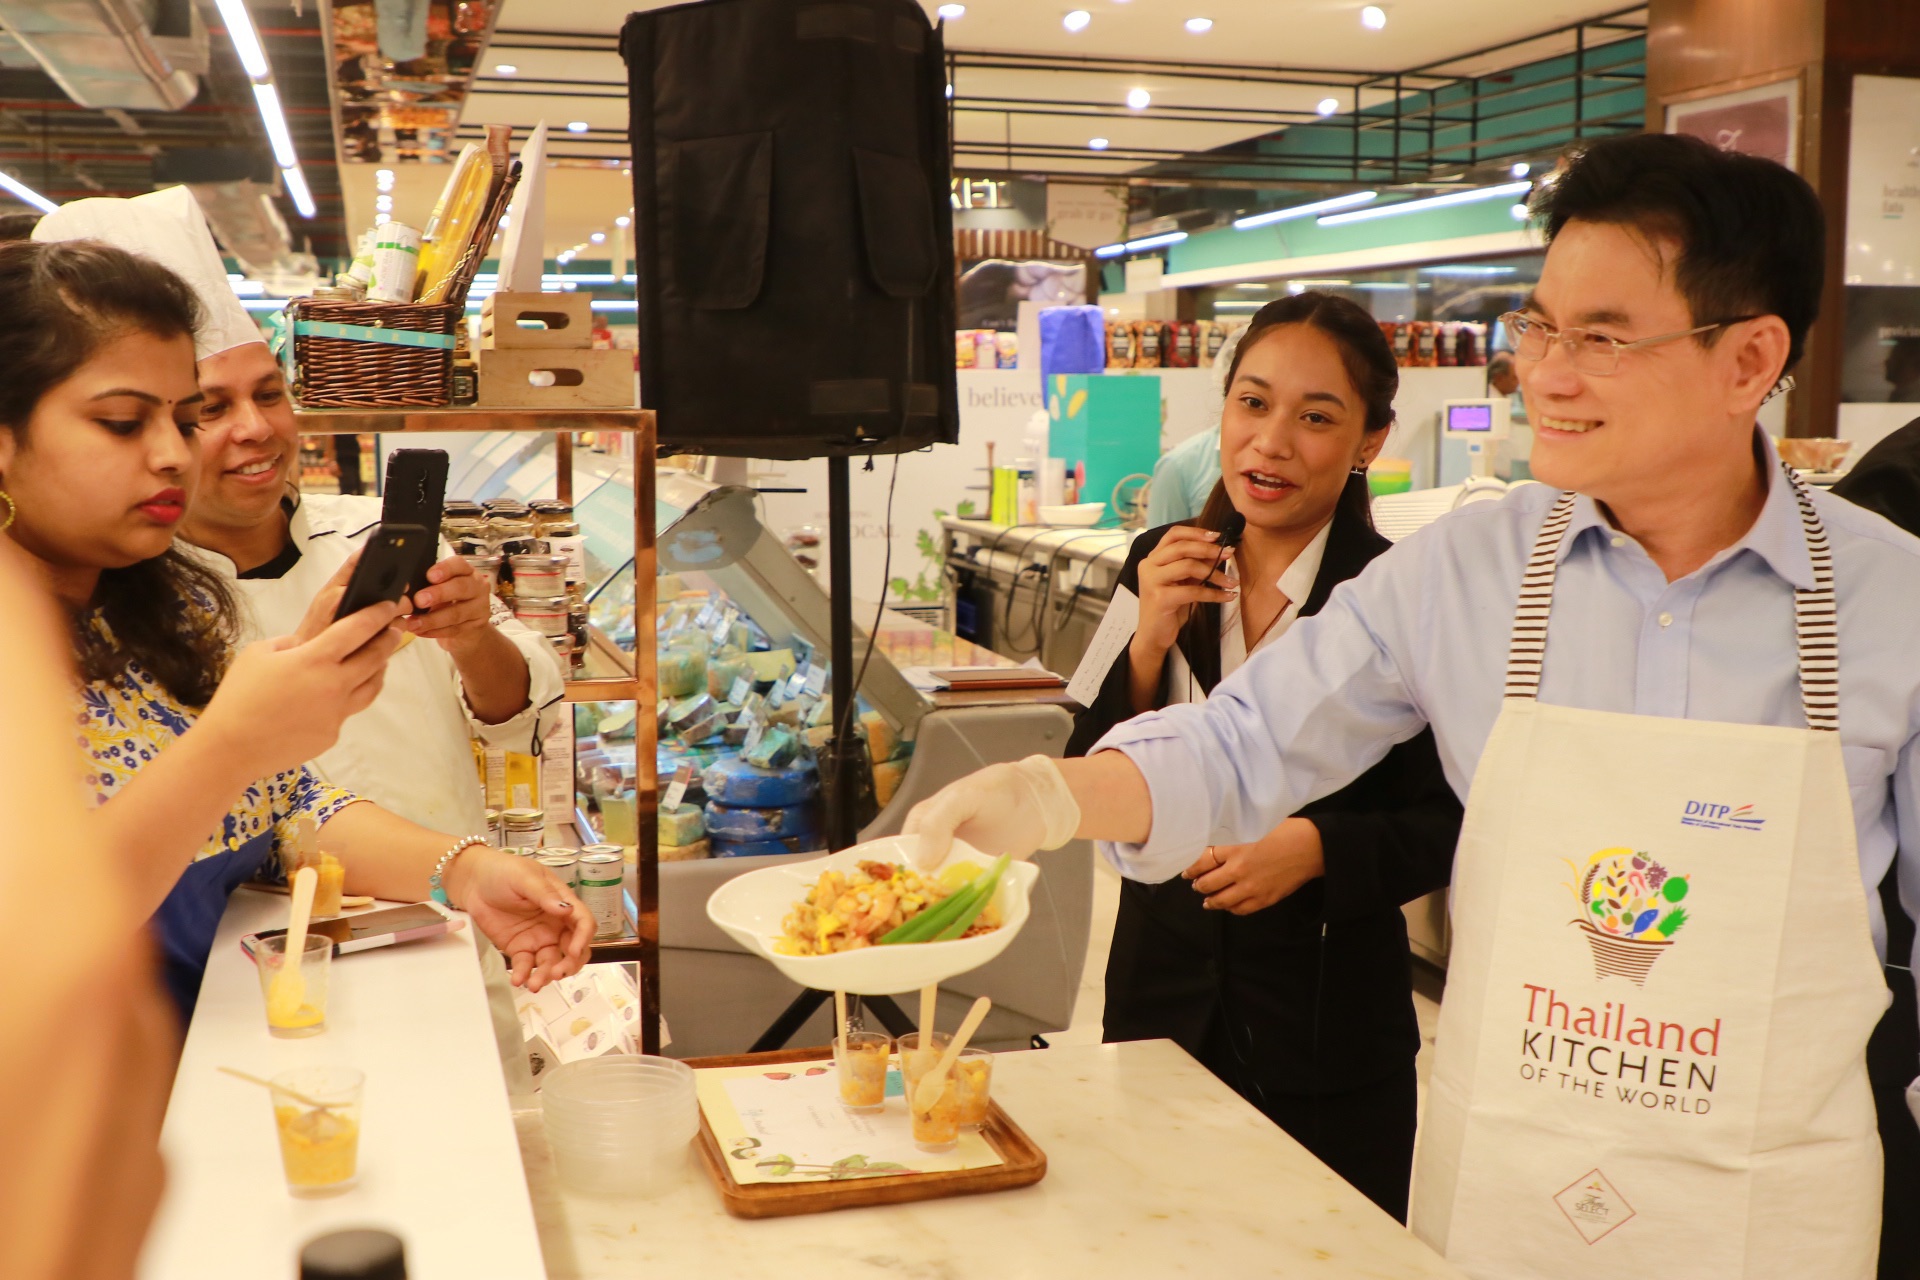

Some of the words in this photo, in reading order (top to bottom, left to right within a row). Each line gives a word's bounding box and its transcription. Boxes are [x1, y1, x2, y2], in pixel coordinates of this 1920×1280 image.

[968, 386, 1041, 408] believe
[1684, 800, 1731, 819] DITP
[1523, 983, 1722, 1057] Thailand
[1522, 1028, 1717, 1093] KITCHEN
[1520, 1063, 1549, 1083] OF
[1558, 1072, 1605, 1099] THE
[1616, 1085, 1712, 1115] WORLD
[1575, 1202, 1609, 1215] SELECT
